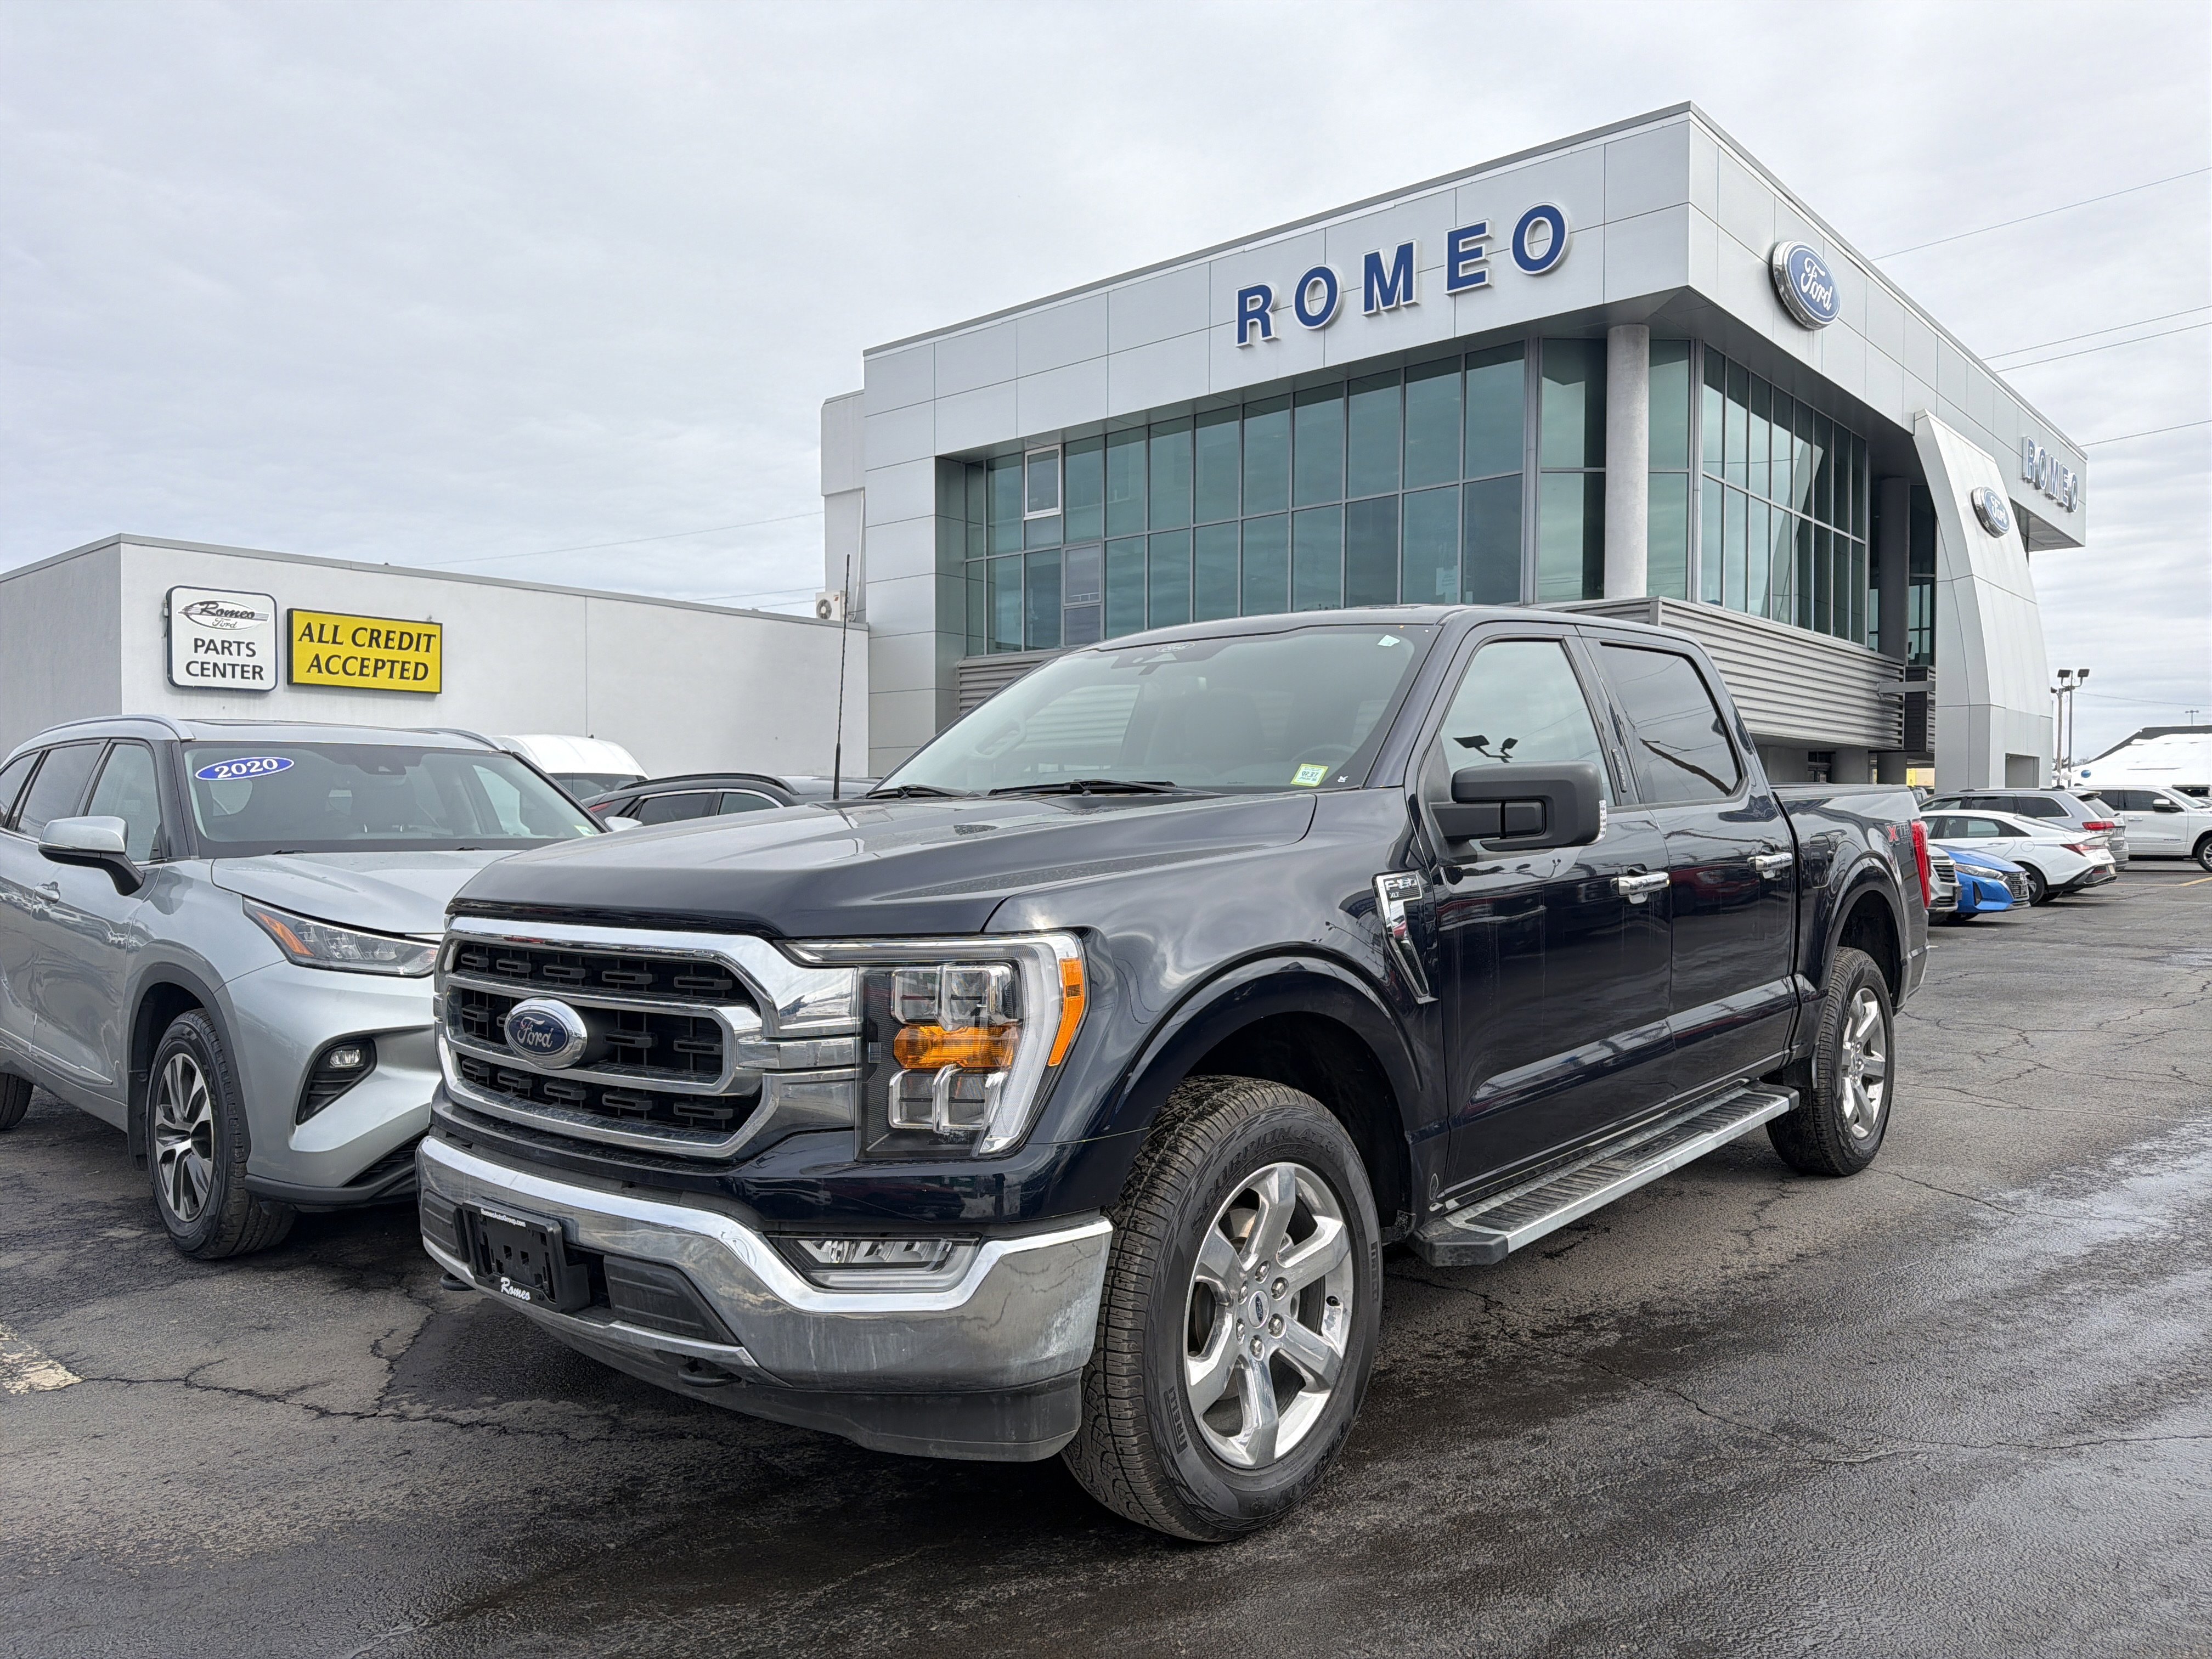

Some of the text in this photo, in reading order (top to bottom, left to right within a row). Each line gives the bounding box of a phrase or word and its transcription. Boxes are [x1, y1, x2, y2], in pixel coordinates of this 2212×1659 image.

[1235, 202, 1570, 348] ROMEO
[1801, 257, 1833, 311] Ford
[2023, 436, 2078, 512] ROMEO
[1990, 495, 2007, 525] Ford
[199, 601, 255, 619] Romeo
[212, 617, 238, 628] Ford
[194, 637, 256, 657] PARTS
[298, 622, 437, 653] ALL CREDIT
[185, 661, 264, 681] CENTER
[306, 653, 429, 681] ACCEPTED
[215, 759, 278, 778] 2020
[517, 1017, 554, 1048] Ford
[1191, 1125, 1292, 1229] SCORPION
[500, 1277, 531, 1300] Romeo
[1164, 1385, 1188, 1454] PIRELLI
